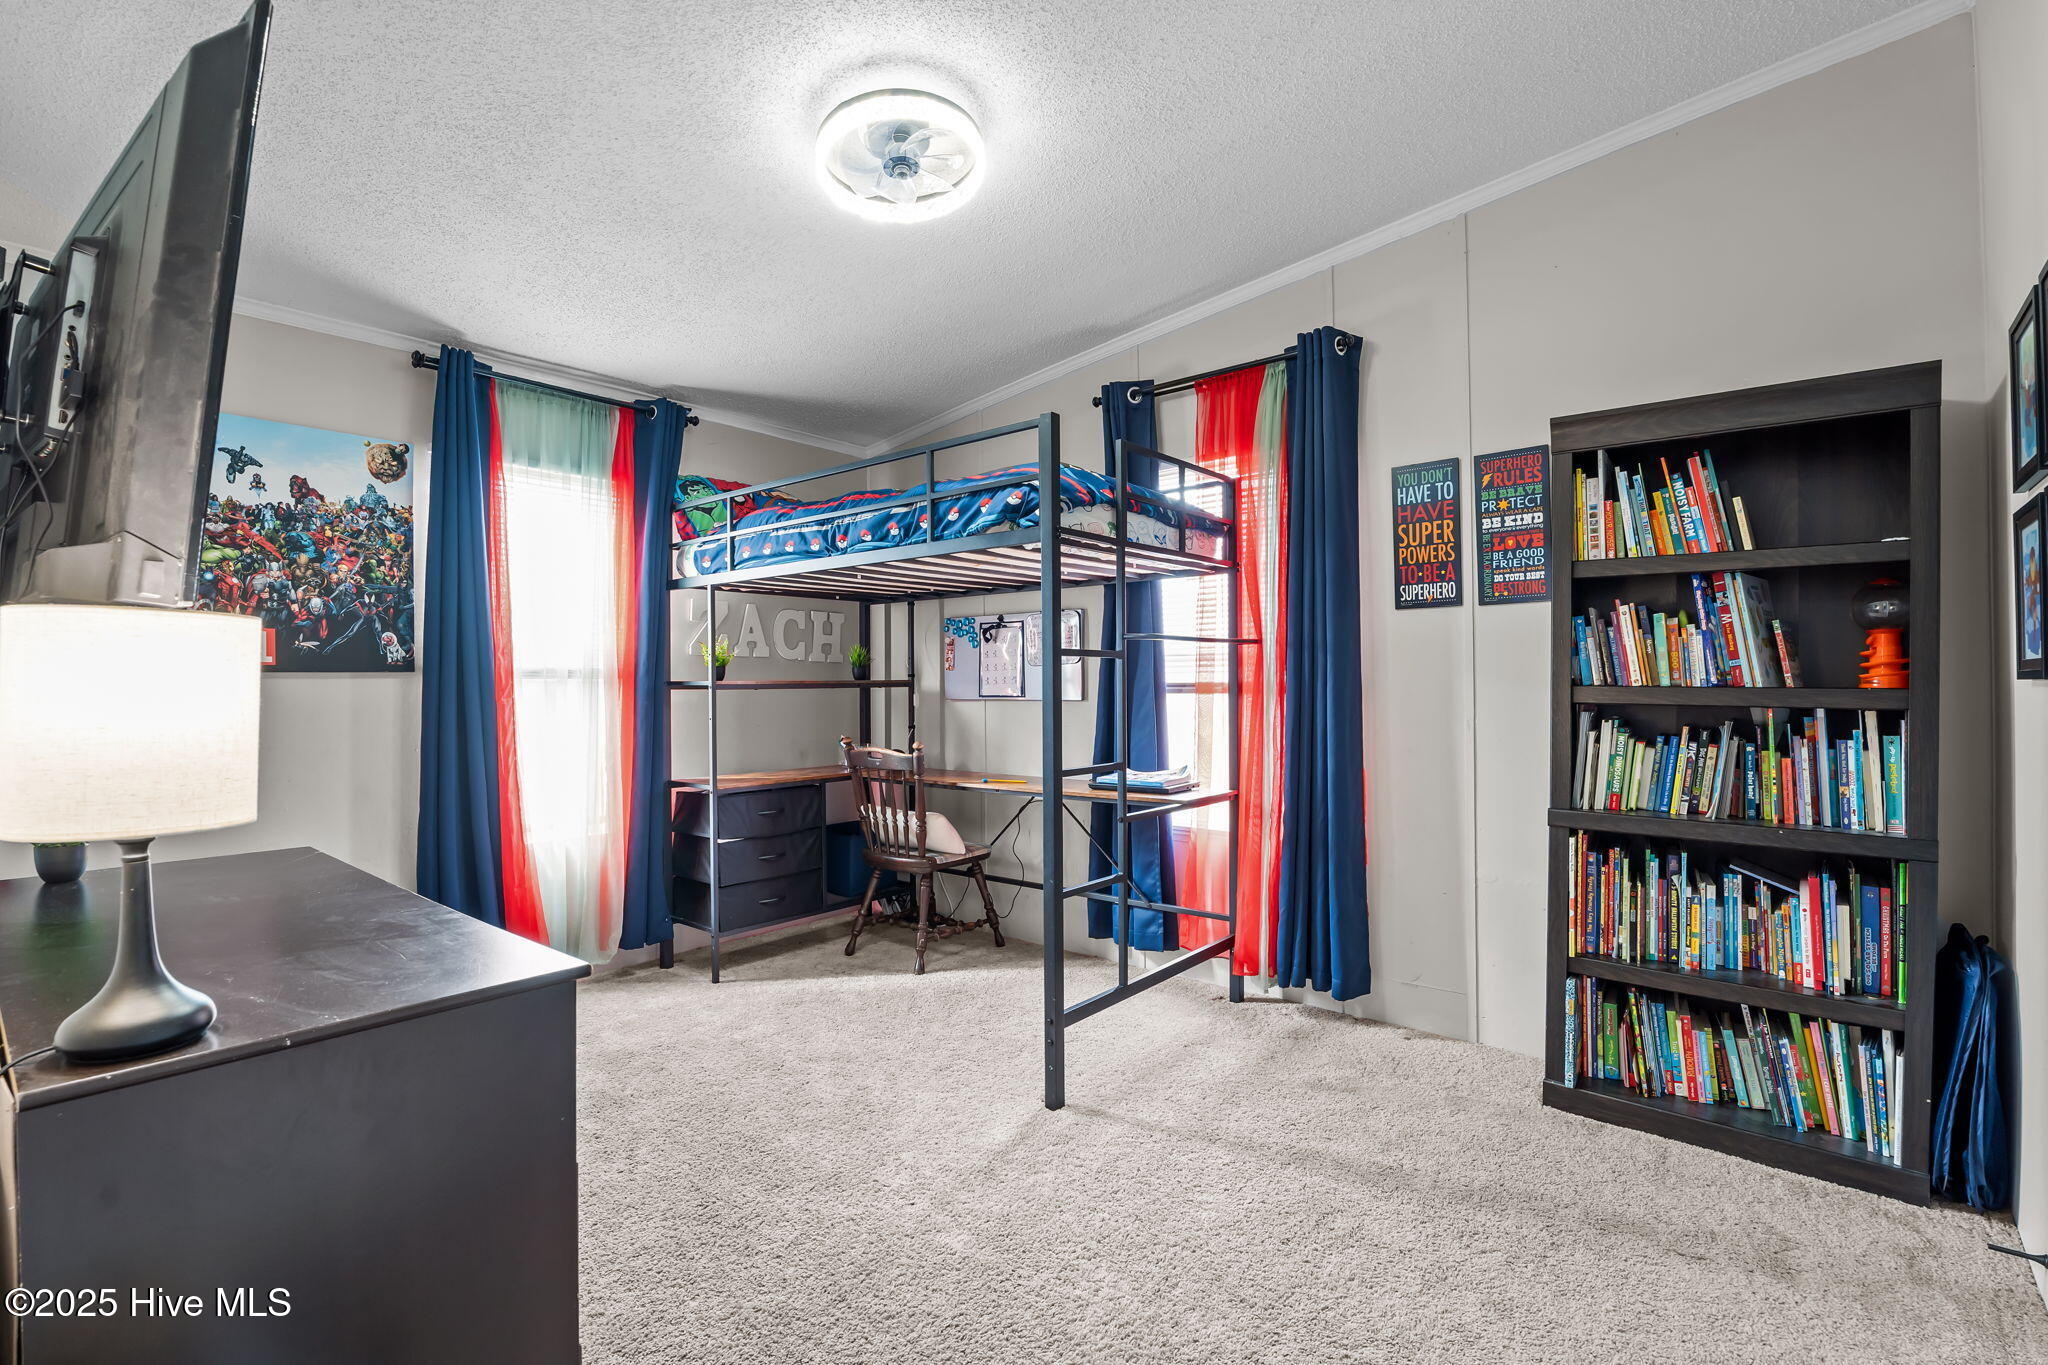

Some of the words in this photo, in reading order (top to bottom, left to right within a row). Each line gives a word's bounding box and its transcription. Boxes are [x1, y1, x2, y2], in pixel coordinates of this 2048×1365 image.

[1480, 453, 1542, 474] SUPERHERO
[1397, 472, 1418, 487] YOU
[1421, 467, 1453, 484] DON'T
[1493, 466, 1543, 487] RULES
[1397, 484, 1431, 506] HAVE
[1435, 481, 1454, 500] TO
[1481, 491, 1497, 500] BE
[1499, 485, 1543, 498] BRAVE
[1397, 500, 1454, 523] HAVE
[1672, 481, 1690, 512] NOISY
[1681, 512, 1697, 537] FARM
[1481, 517, 1502, 530] BE
[1504, 512, 1544, 527] KIND
[1398, 519, 1455, 547] SUPER
[1493, 533, 1544, 551] LOVE
[1399, 543, 1455, 565] POWERS
[1493, 552, 1504, 560] BE
[1507, 551, 1514, 559] A
[1516, 547, 1545, 558] GOOD
[1493, 557, 1545, 569] FRIEND
[1399, 565, 1418, 585] TO
[1423, 563, 1441, 583] BE
[1445, 562, 1456, 581] A
[1504, 572, 1525, 582] YOUR
[1526, 571, 1545, 580] BEST
[1400, 581, 1456, 601] SUPERHERO
[688, 598, 845, 663] ZACH
[1616, 735, 1625, 756] NOISY
[1612, 756, 1623, 793] DINOSAURS
